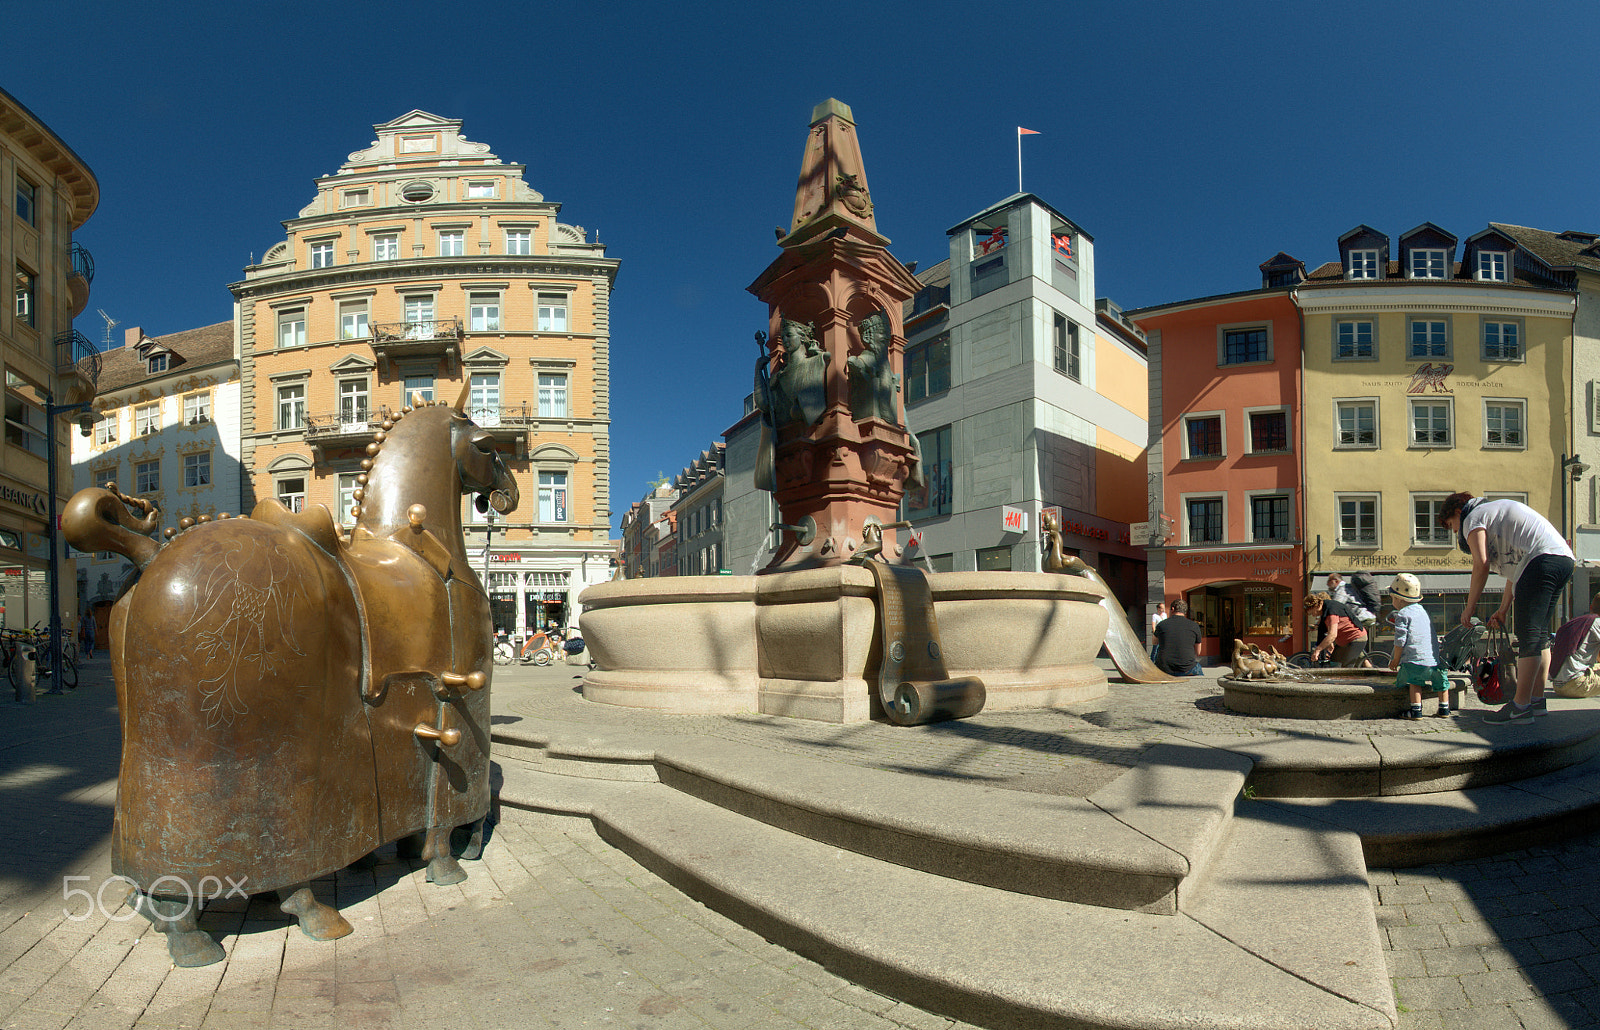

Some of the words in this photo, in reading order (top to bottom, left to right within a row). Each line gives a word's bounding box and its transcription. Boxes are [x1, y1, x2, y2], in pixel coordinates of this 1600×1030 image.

[1005, 511, 1021, 529] H&M
[1180, 550, 1292, 567] GRUNDMANN
[1252, 566, 1292, 576] Juwelier
